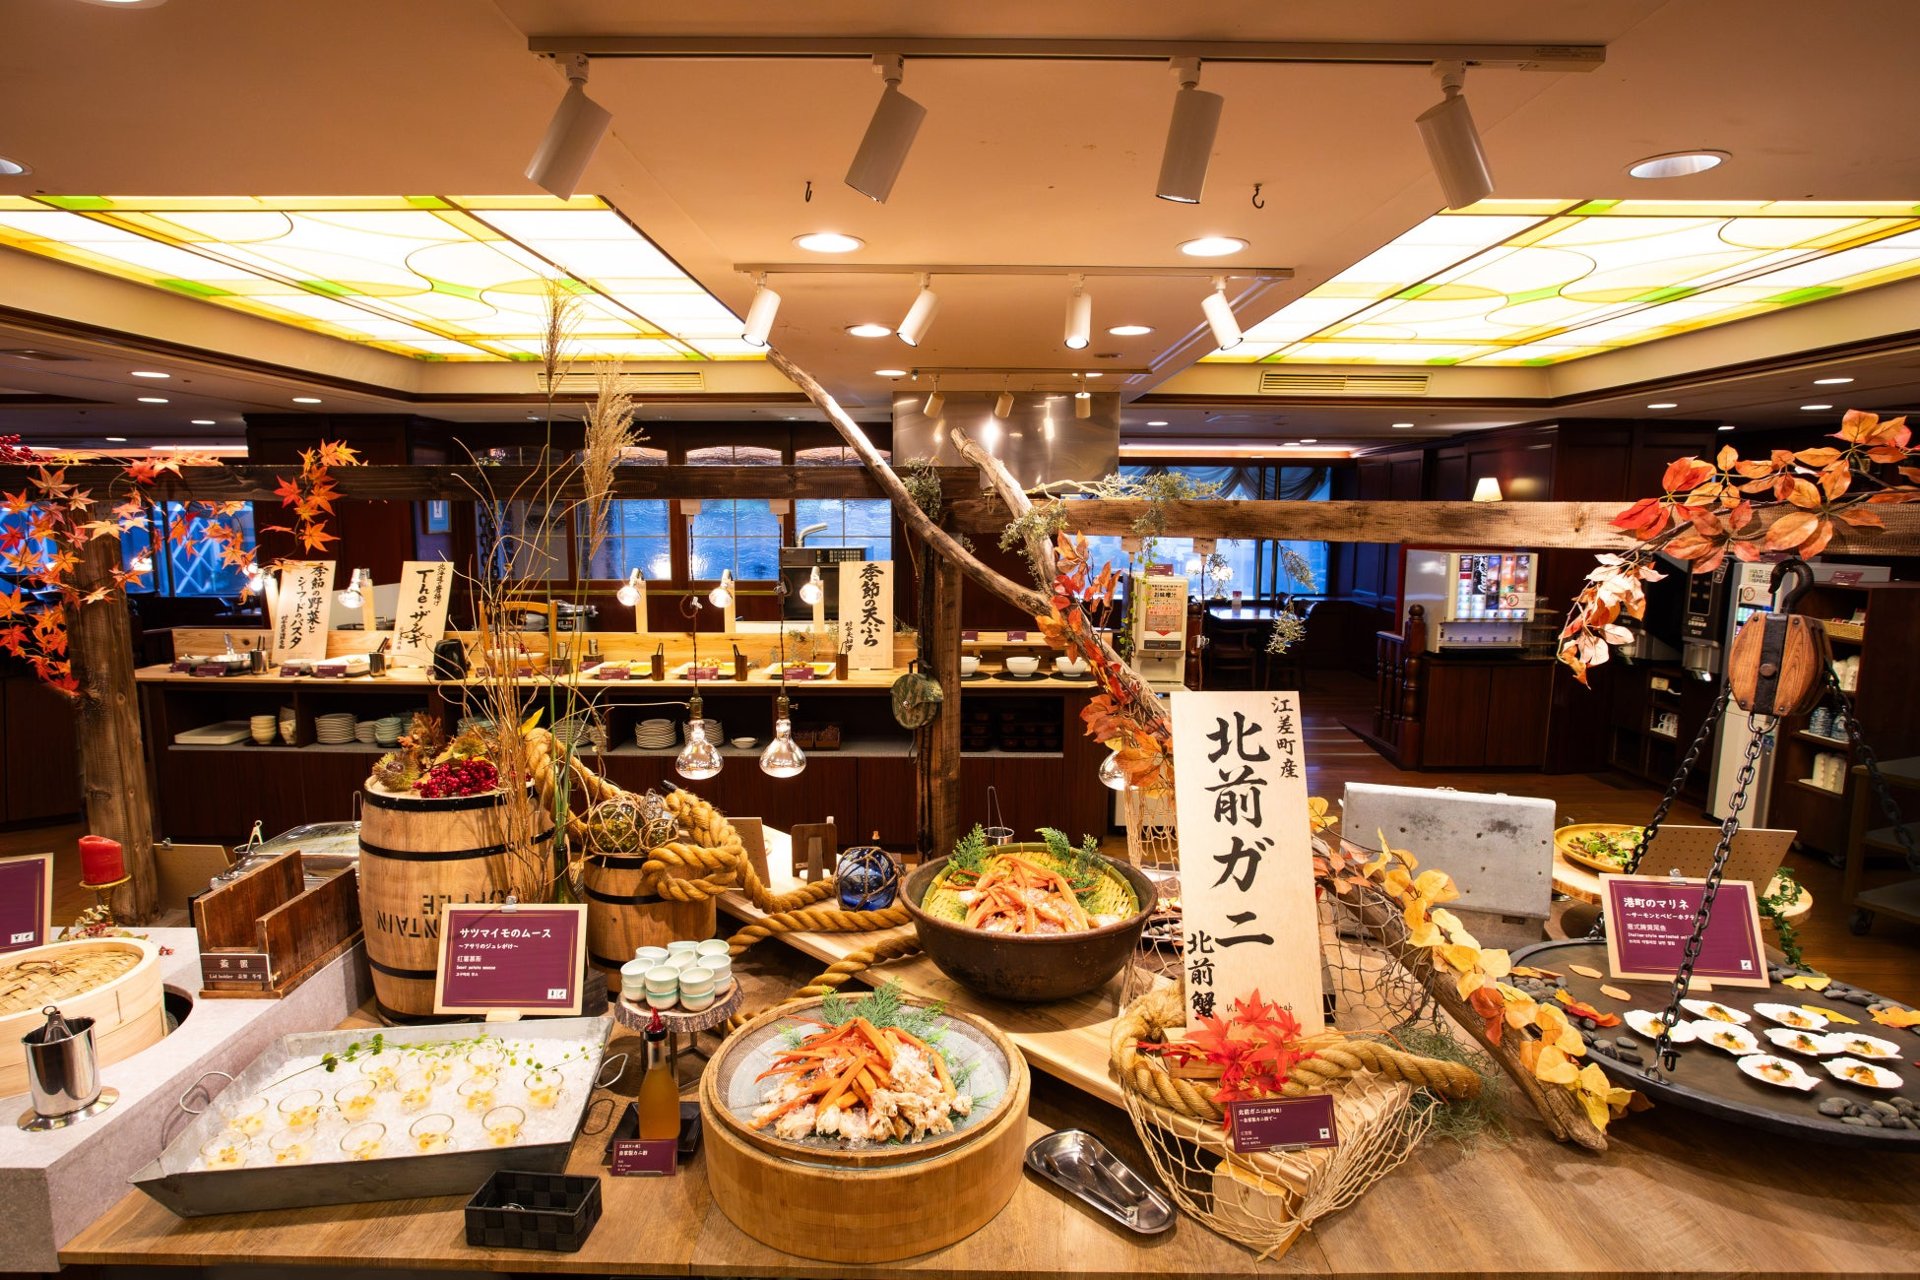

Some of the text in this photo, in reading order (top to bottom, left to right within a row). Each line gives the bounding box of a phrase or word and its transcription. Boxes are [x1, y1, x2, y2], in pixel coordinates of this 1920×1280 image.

[289, 576, 307, 650] シーフードのパスタ
[859, 563, 886, 647] 季節の天ぷら
[1271, 696, 1299, 779] 江差町産
[1204, 711, 1275, 948] 北前ガニ
[377, 911, 438, 939] NTAIN
[459, 927, 552, 939] サツマイモのムース
[1623, 897, 1690, 910] 港町のマリネ
[1187, 930, 1217, 1020] 北前蟹
